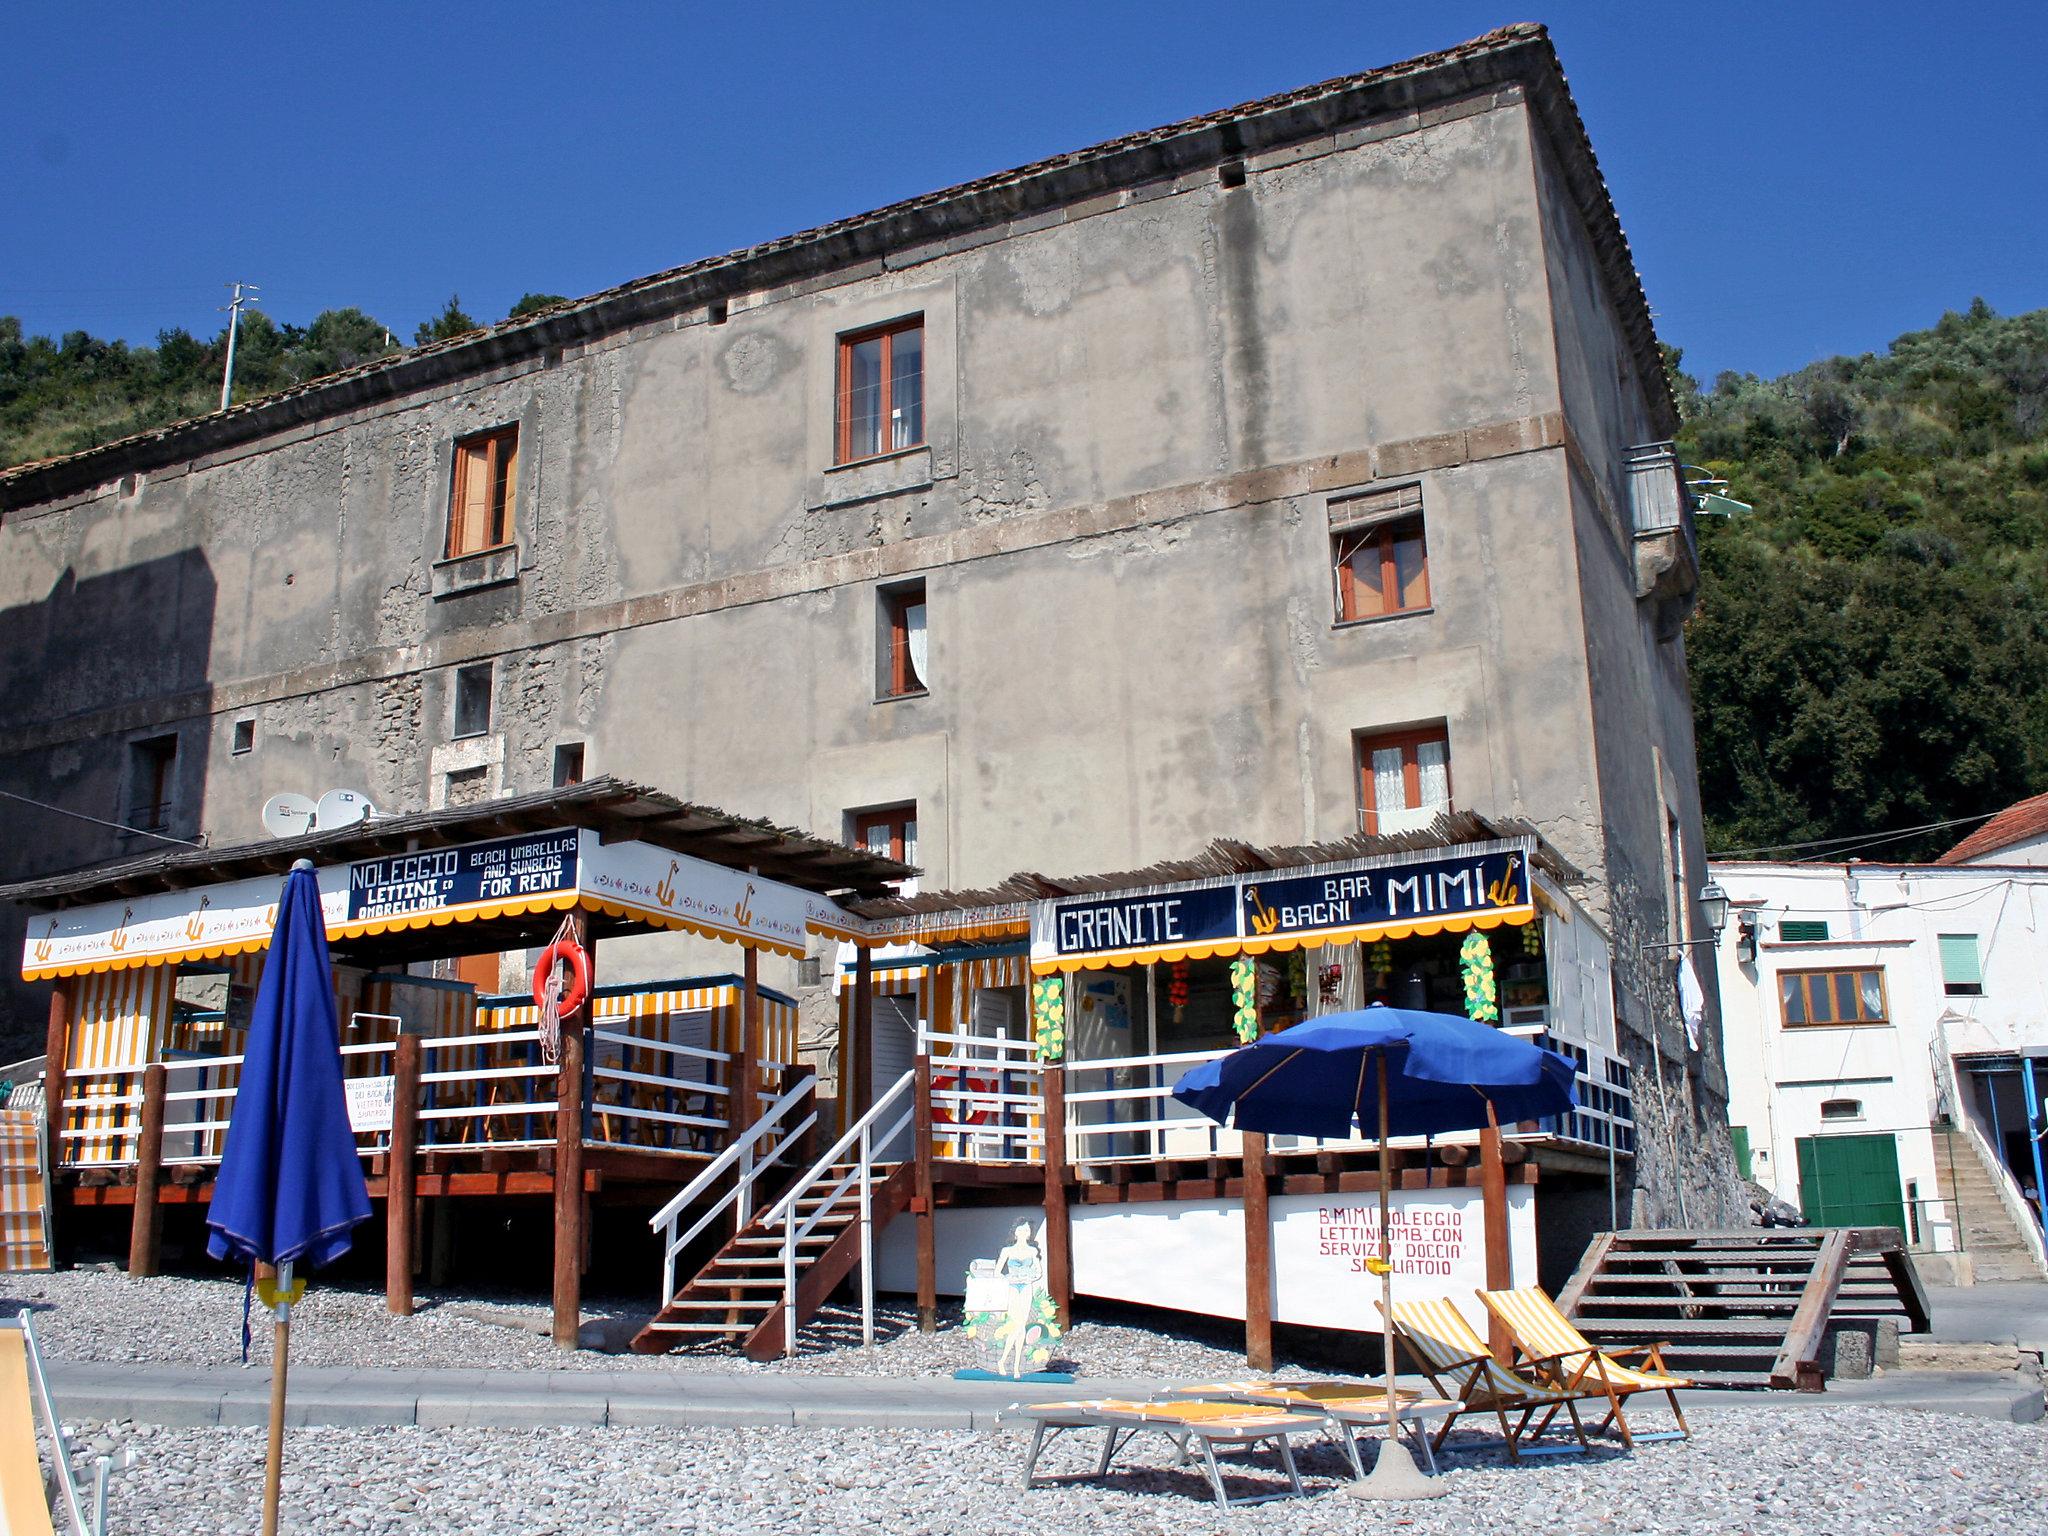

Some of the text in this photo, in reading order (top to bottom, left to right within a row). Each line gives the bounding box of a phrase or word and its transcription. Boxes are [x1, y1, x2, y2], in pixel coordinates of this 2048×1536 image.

[470, 837, 577, 867] BEACH UMBRELLAS
[352, 851, 458, 891] NOLEGGIO
[483, 855, 562, 880] AND SUNBEDS
[367, 880, 437, 905] LETTINI
[480, 870, 563, 899] FOR RENT
[1324, 876, 1372, 901] BAR
[358, 894, 447, 919] OMBRELLONI
[1281, 900, 1351, 928] BAGNI
[1060, 900, 1184, 951] GRANITE
[1432, 1228, 1462, 1243] CON
[1351, 1259, 1451, 1275] SLIATOIO
